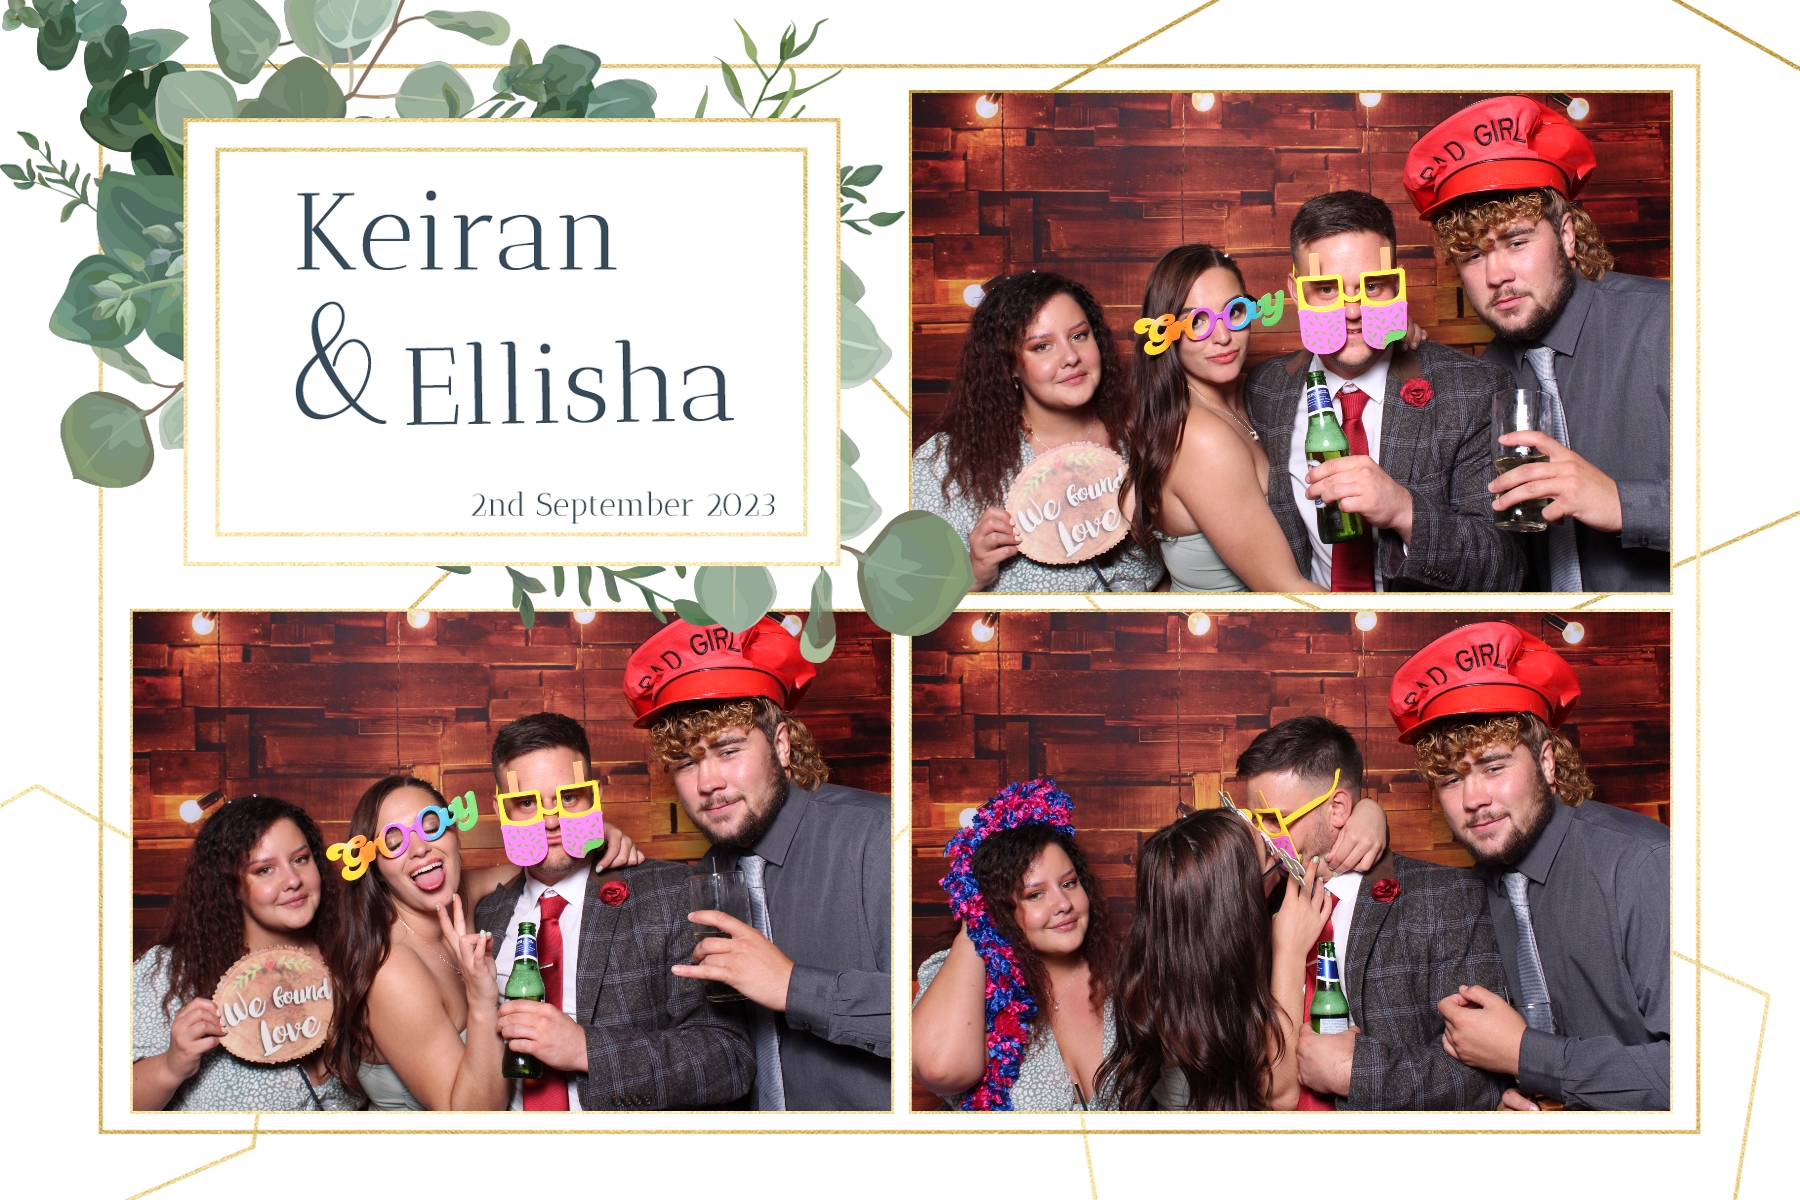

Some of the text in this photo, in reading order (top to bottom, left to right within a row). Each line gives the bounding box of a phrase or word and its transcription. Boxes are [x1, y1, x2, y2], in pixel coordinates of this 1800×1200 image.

[1473, 117, 1526, 147] GIRL
[1017, 467, 1125, 533] We found
[1058, 508, 1121, 558] Love
[689, 627, 742, 656] GIRL
[1455, 643, 1507, 672] GIRL
[223, 977, 333, 1027] We found
[260, 1015, 322, 1057] Love
